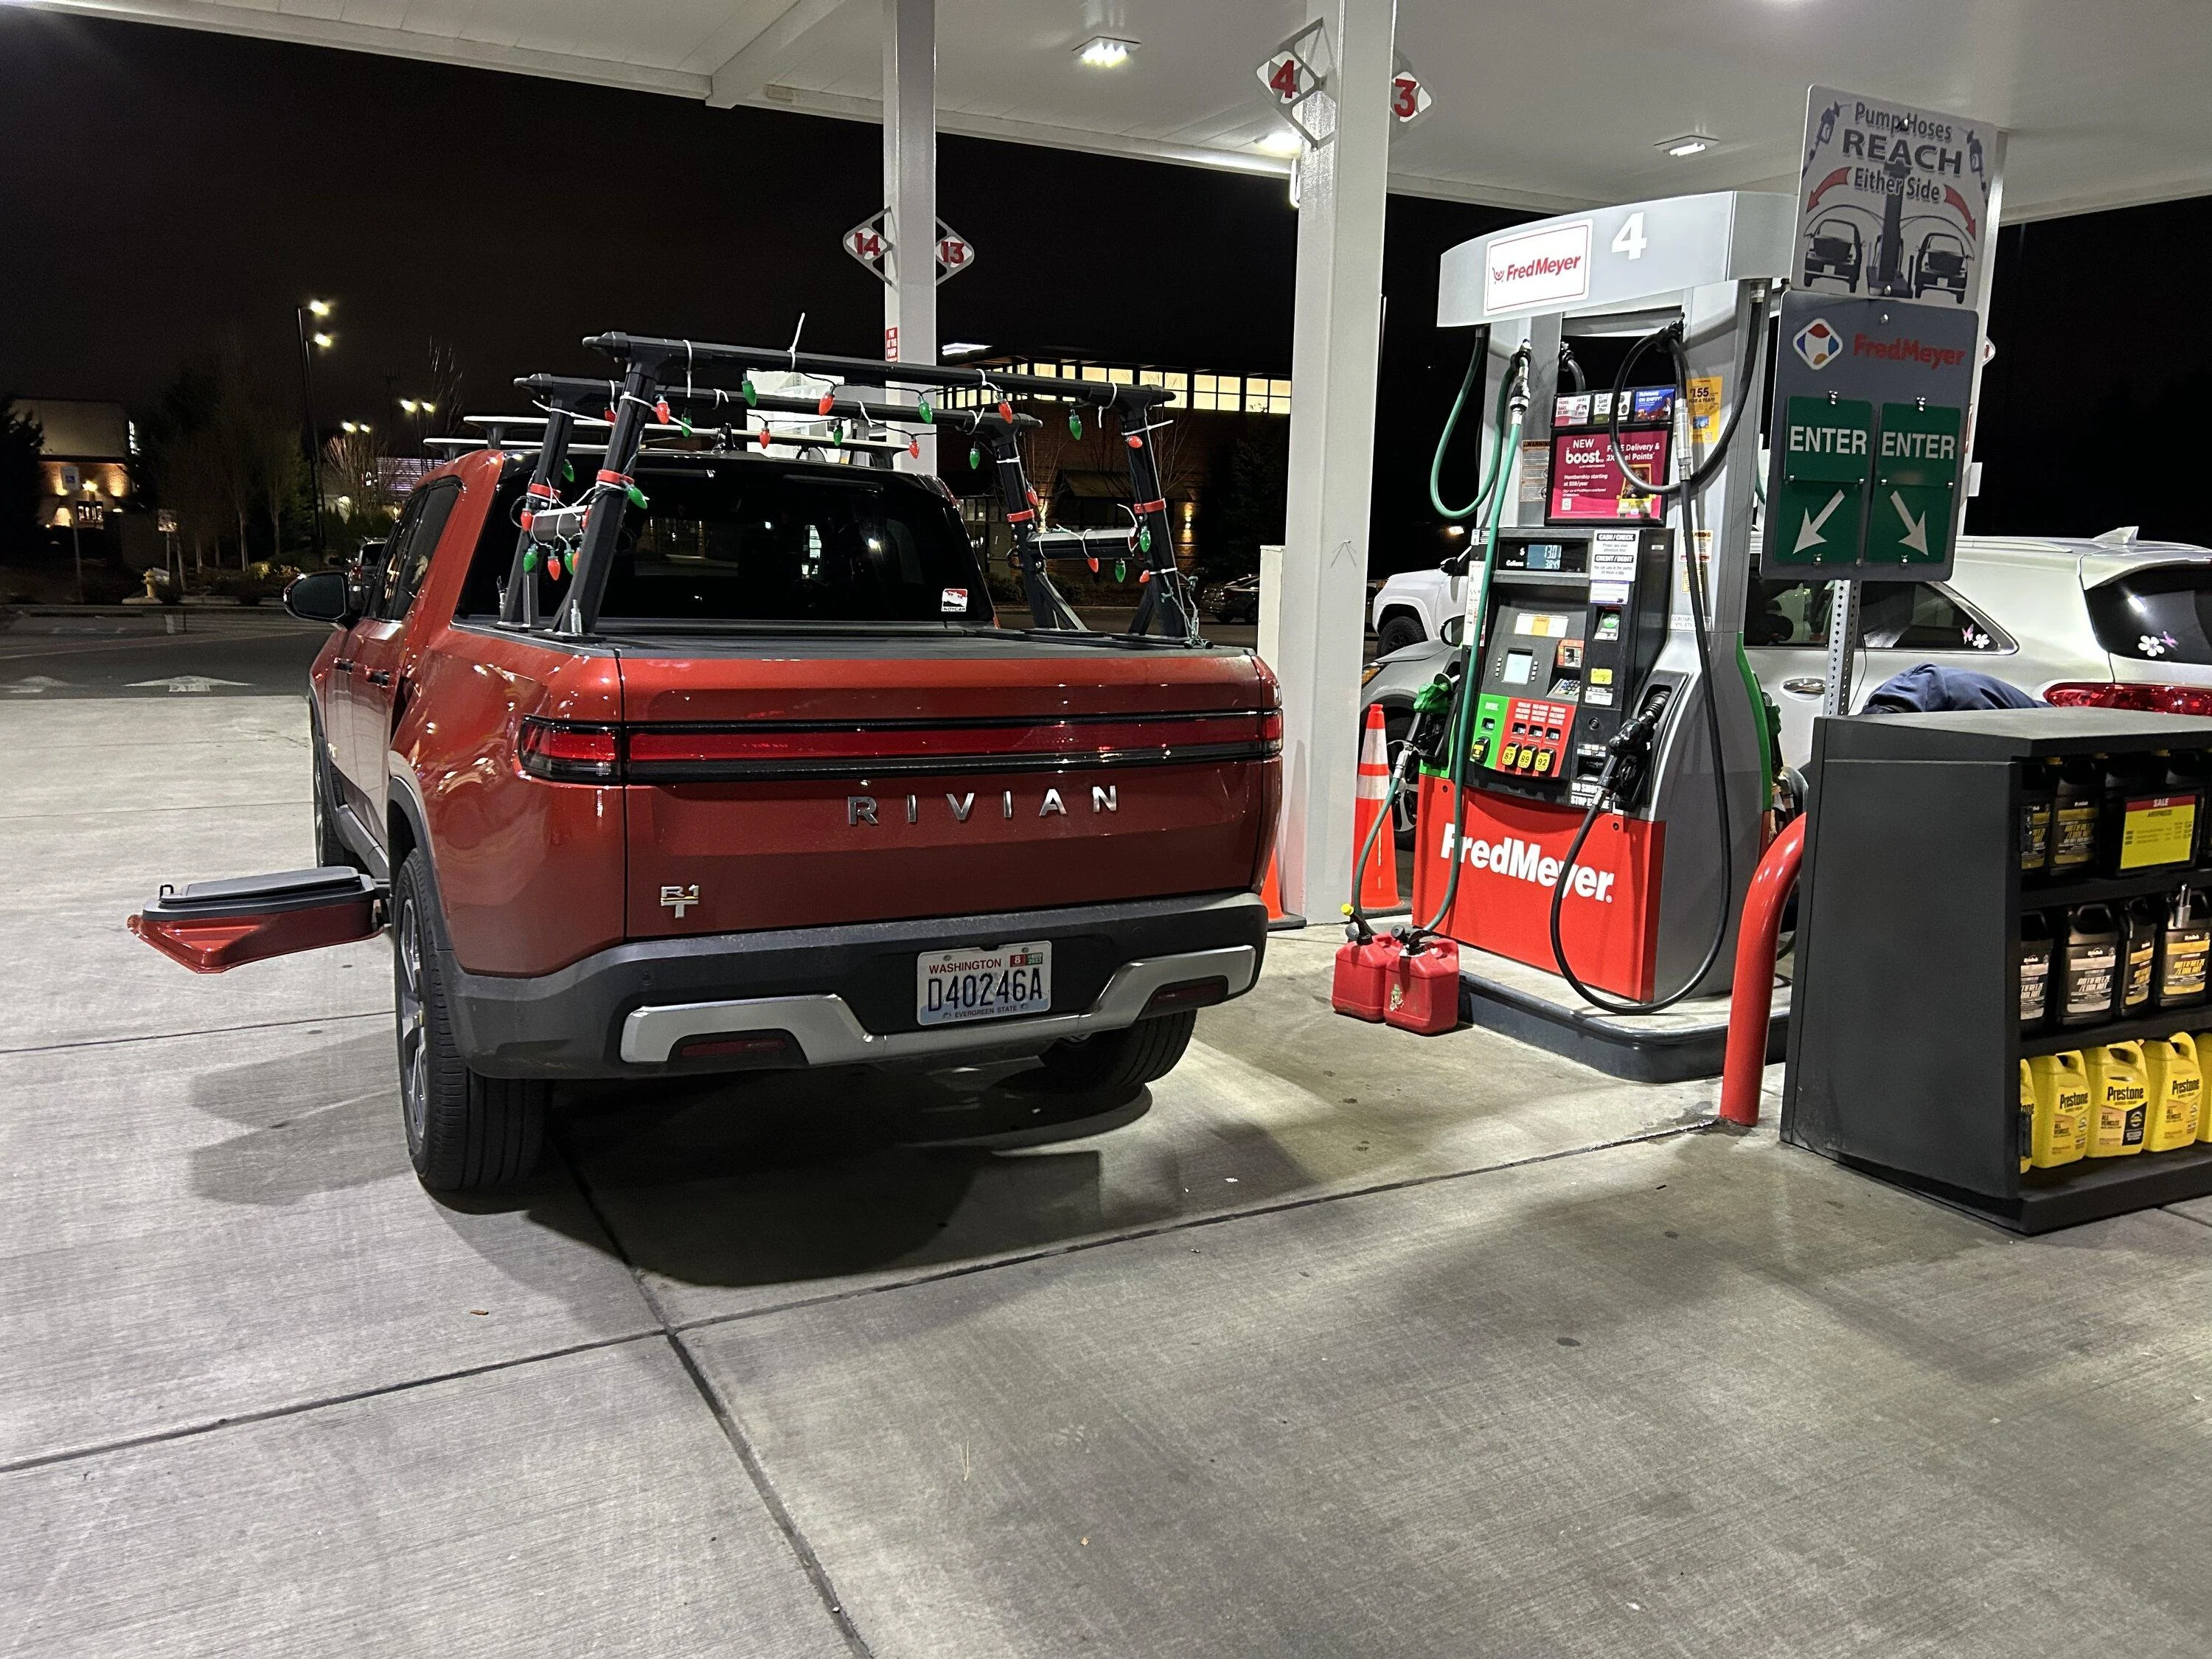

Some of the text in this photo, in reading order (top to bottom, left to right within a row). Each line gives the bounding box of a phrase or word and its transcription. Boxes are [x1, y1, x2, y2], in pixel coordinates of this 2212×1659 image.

[1270, 60, 1297, 99] 4
[1394, 78, 1416, 117] 3
[1855, 102, 1952, 141] Pump Hoses
[1843, 128, 1962, 175] REACH
[1854, 167, 1941, 203] Either Side
[855, 232, 880, 256] 14
[1612, 211, 1647, 260] 4
[941, 241, 964, 264] 13
[1573, 439, 1594, 448] NEW
[1626, 442, 1654, 452] Delivery
[1790, 425, 1868, 455] ENTER
[1880, 431, 1955, 460] ENTER
[1520, 755, 1530, 763] 89
[1537, 758, 1547, 766] 92
[846, 785, 1118, 826] RIVIAN
[2153, 798, 2169, 807] SALE
[929, 959, 1001, 974] WASHINGTON
[1015, 956, 1021, 964] 8
[928, 967, 1042, 1012] D40246A
[955, 1004, 1018, 1018] EVERGREEN STATE
[2107, 1086, 2143, 1102] Prestone
[2172, 1079, 2199, 1095] Prestone
[2059, 1092, 2088, 1109] Prestone
